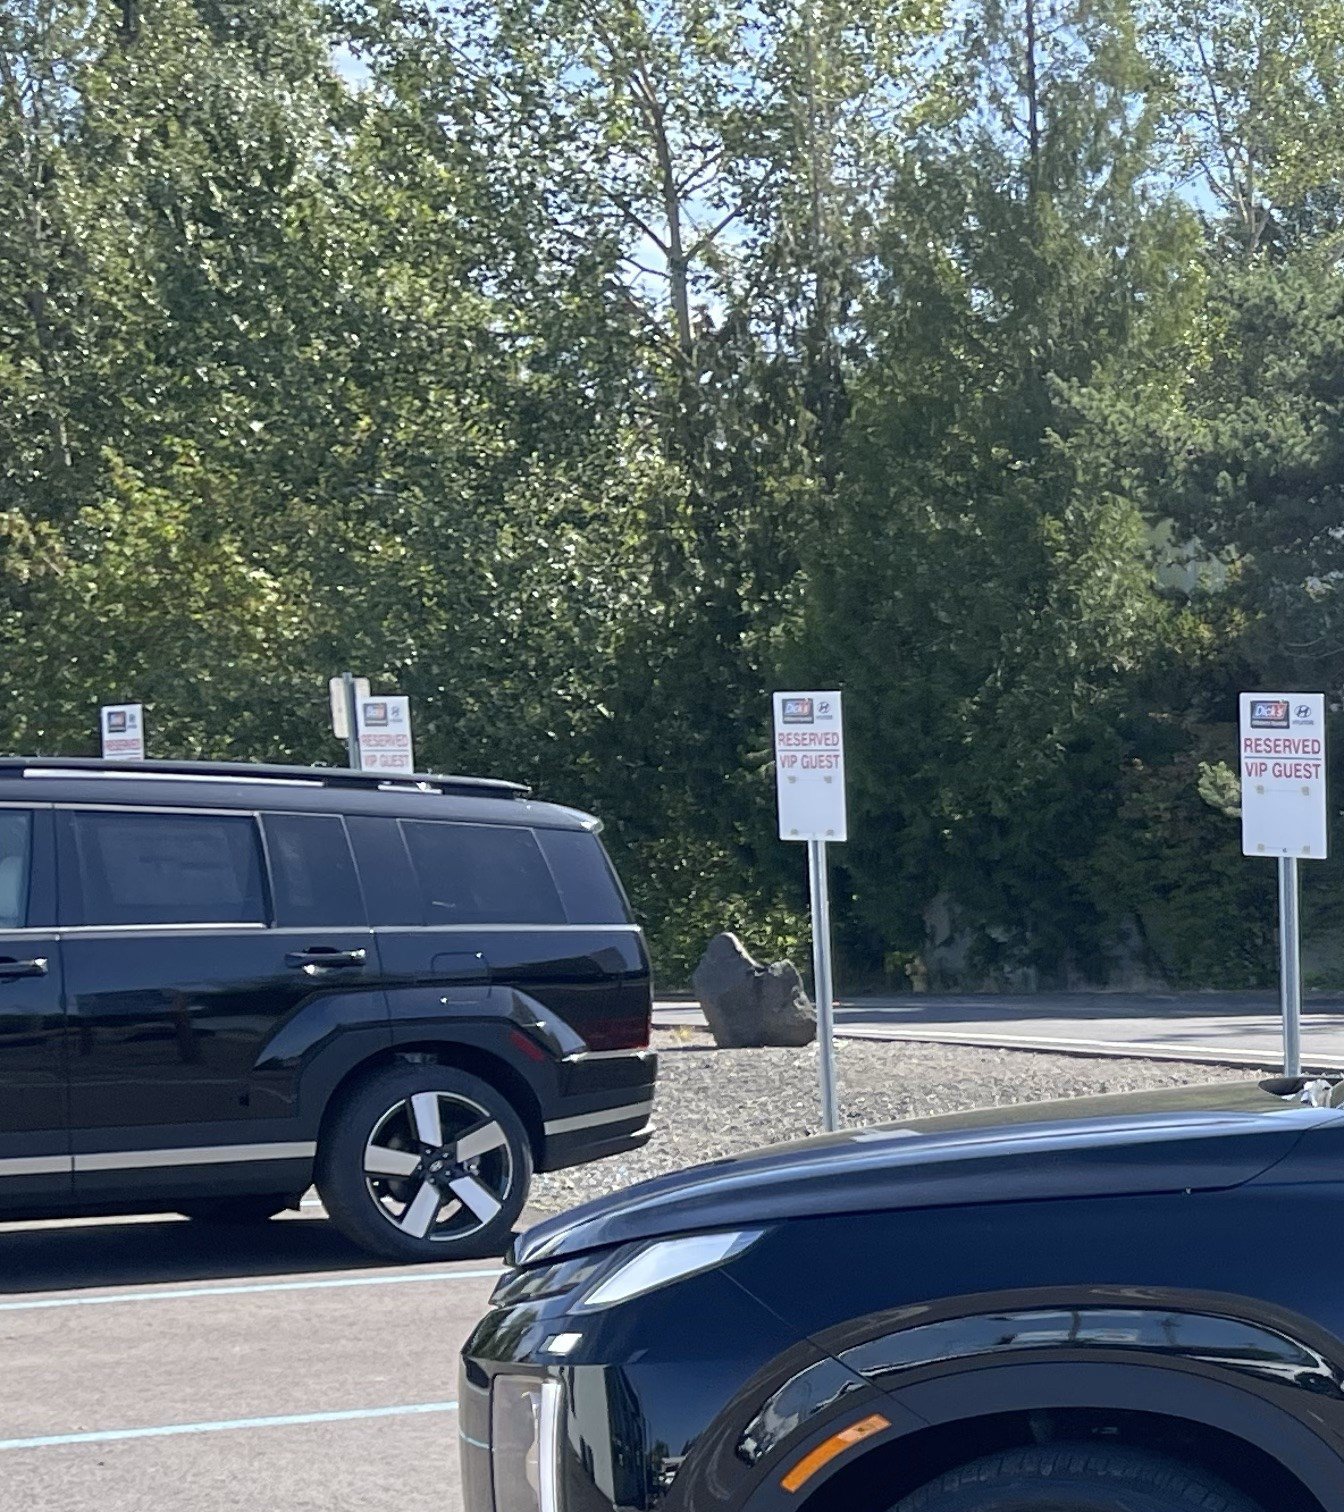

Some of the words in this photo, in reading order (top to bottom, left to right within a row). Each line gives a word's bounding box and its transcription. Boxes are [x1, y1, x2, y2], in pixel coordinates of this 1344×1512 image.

[778, 732, 840, 747] RESERVED
[1244, 738, 1321, 755] RESERVED
[779, 755, 798, 768] VIP
[801, 755, 840, 769] GUEST
[1244, 762, 1268, 778] VIP
[1272, 763, 1321, 779] GUEST
